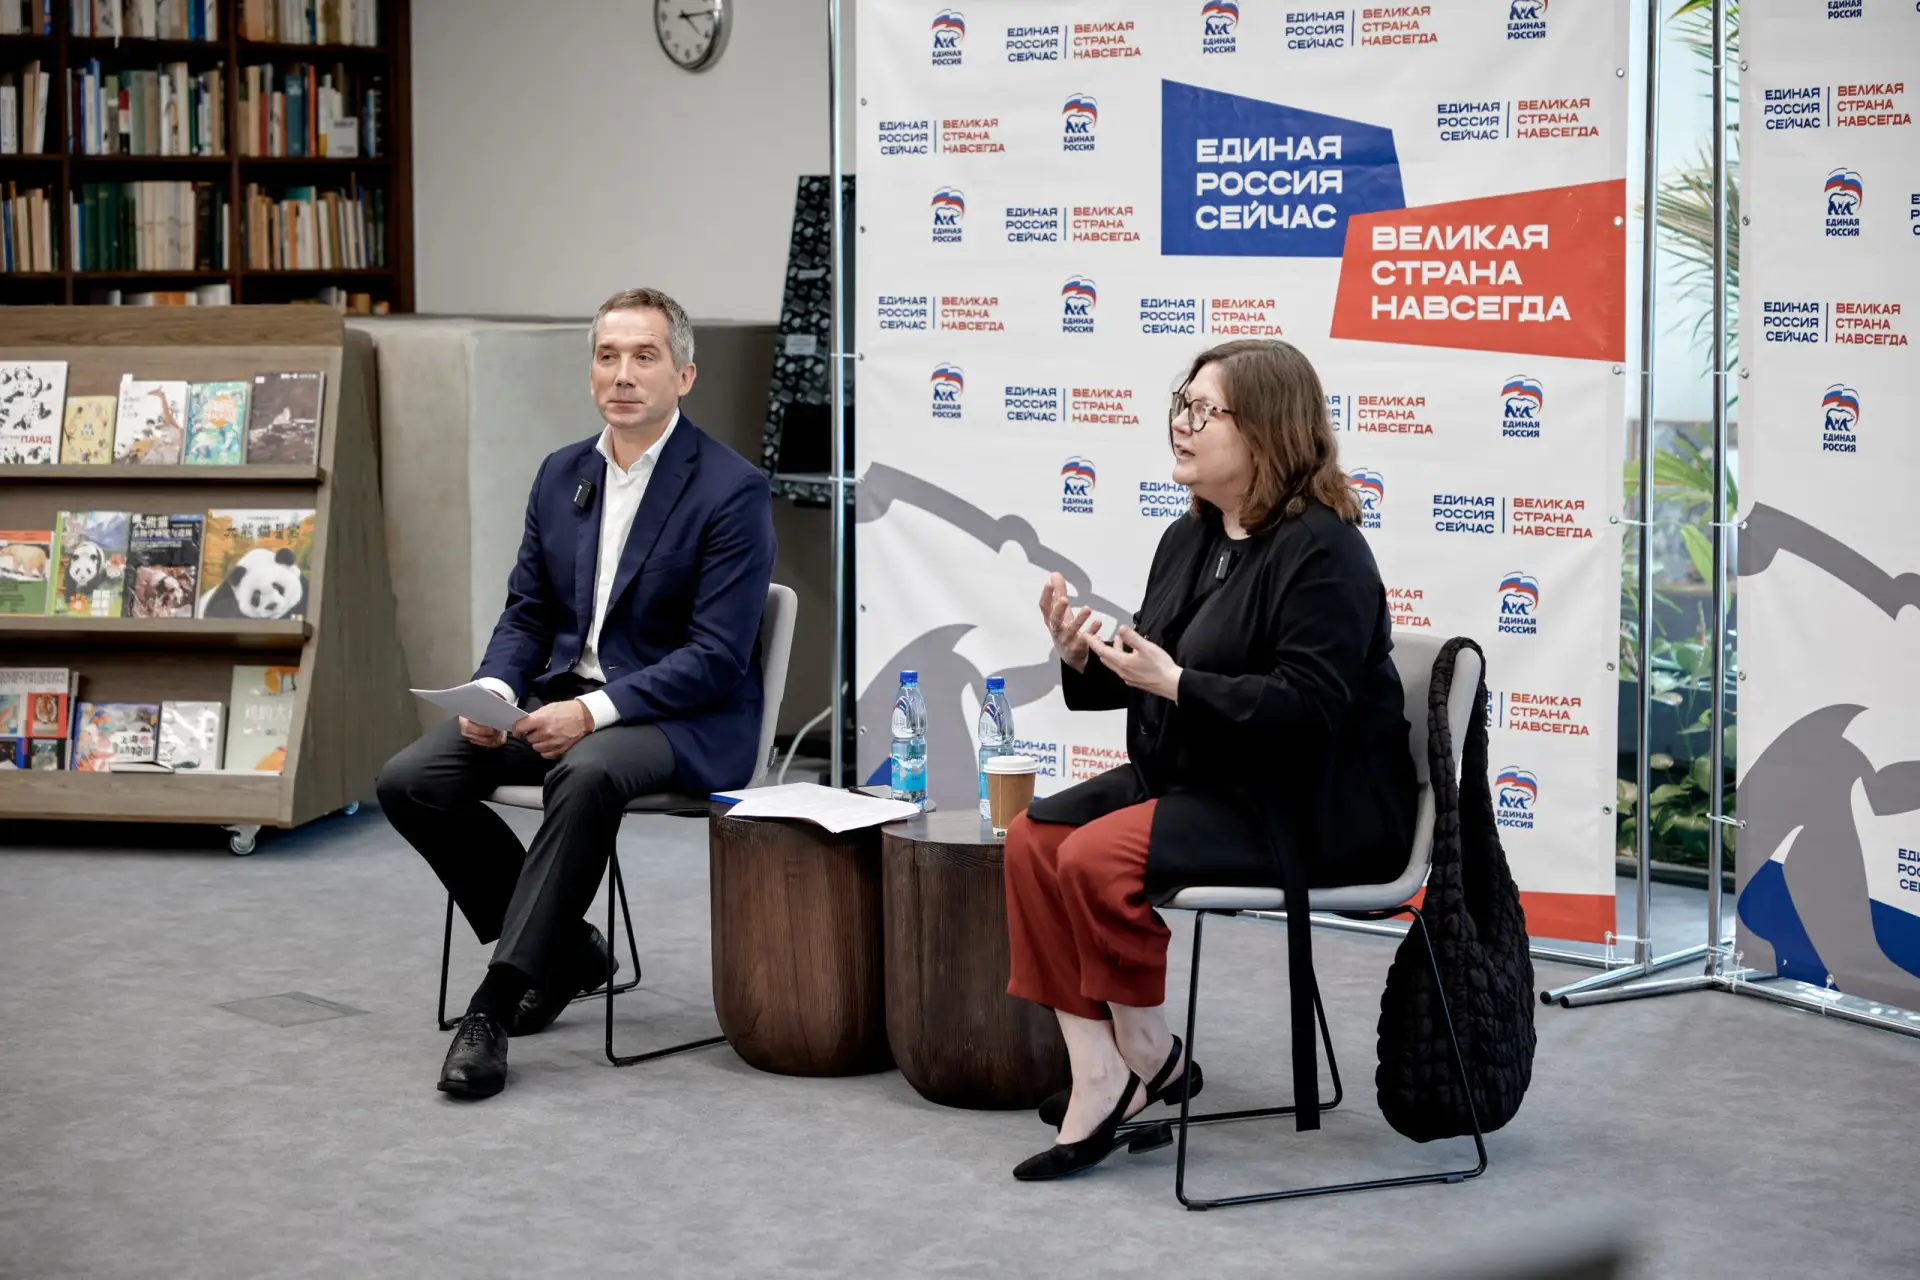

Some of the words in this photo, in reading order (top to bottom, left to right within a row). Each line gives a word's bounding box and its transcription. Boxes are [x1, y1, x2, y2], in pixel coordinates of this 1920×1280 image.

[1828, 0, 1862, 10] ЕДИНАЯ
[1286, 11, 1344, 23] ЕДИНАЯ
[1363, 6, 1431, 18] ВЕЛИКАЯ
[1828, 9, 1862, 19] РОССИЯ
[1008, 26, 1059, 37] ЕДИНАЯ
[1074, 22, 1134, 34] ВЕЛИКАЯ
[1286, 24, 1344, 36] РОССИЯ
[1362, 20, 1420, 32] СТРАНА
[1508, 22, 1546, 30] ЕДИНАЯ
[1362, 33, 1438, 46] НАВСЕГДА
[1508, 30, 1546, 39] РОССИЯ
[1006, 39, 1058, 50] РОССИЯ
[1074, 35, 1125, 46] СТРАНА
[1203, 37, 1236, 46] ЕДИНАЯ
[1288, 37, 1344, 50] СЕЙЧАС
[932, 50, 962, 58] ЕДИНАЯ
[1074, 47, 1141, 58] НАВСЕГДА
[1203, 45, 1236, 54] РОССИЯ
[1008, 50, 1058, 62] СЕЙЧАС
[932, 58, 962, 66] РОССИЯ
[1765, 87, 1820, 100] ЕДИНАЯ
[1838, 83, 1904, 96] ВЕЛИКАЯ
[1438, 102, 1500, 114] ЕДИНАЯ
[1518, 98, 1590, 110] ВЕЛИКАЯ
[1764, 102, 1820, 115] РОССИЯ
[1837, 99, 1894, 112] СТРАНА
[942, 118, 998, 129] ВЕЛИКАЯ
[1438, 116, 1499, 128] РОССИЯ
[1518, 113, 1579, 124] СТРАНА
[1766, 117, 1820, 130] СЕЙЧАС
[1838, 114, 1912, 127] НАВСЕГДА
[879, 120, 928, 131] ЕДИНАЯ
[943, 132, 990, 141] СТРАНА
[1440, 129, 1498, 141] СЕЙЧАС
[1518, 126, 1599, 138] НАВСЕГДА
[879, 133, 928, 143] РОССИЯ
[1064, 136, 1094, 144] ЕДИНАЯ
[881, 144, 927, 155] СЕЙЧАС
[943, 144, 1005, 153] НАВСЕГДА
[1197, 136, 1342, 164] ЕДИНАЯ
[1197, 170, 1342, 196] РОССИЯ
[1006, 208, 1058, 217] ЕДИНАЯ
[1074, 206, 1133, 216] ВЕЛИКАЯ
[1196, 200, 1336, 230] СЕЙЧАС
[1006, 220, 1058, 230] РОССИЯ
[1073, 220, 1124, 228] СТРАНА
[1826, 218, 1859, 227] ЕДИНАЯ
[1008, 232, 1057, 242] СЕЙЧАС
[1073, 232, 1140, 241] НАВСЕГДА
[1372, 224, 1548, 250] ВЕЛИКАЯ
[1826, 228, 1859, 236] РОССИЯ
[1372, 260, 1522, 285] СТРАНА
[879, 296, 927, 305] ЕДИНАЯ
[942, 296, 998, 306] ВЕЛИКАЯ
[1140, 298, 1195, 308] ЕДИНАЯ
[1212, 299, 1275, 308] ВЕЛИКАЯ
[878, 308, 927, 318] РОССИЯ
[1372, 295, 1571, 322] НАВСЕГДА
[1764, 302, 1819, 313] ЕДИНАЯ
[1836, 303, 1900, 314] ВЕЛИКАЯ
[942, 309, 990, 318] СТРАНА
[1140, 312, 1195, 321] РОССИЯ
[1212, 312, 1265, 322] СТРАНА
[880, 320, 926, 330] СЕЙЧАС
[942, 322, 1004, 331] НАВСЕГДА
[1764, 316, 1818, 328] РОССИЯ
[1836, 318, 1890, 330] СТРАНА
[1142, 323, 1194, 334] СЕЙЧАС
[1212, 326, 1282, 335] НАВСЕГДА
[1766, 330, 1818, 343] СЕЙЧАС
[1836, 333, 1908, 346] НАВСЕГДА
[1005, 386, 1056, 396] ЕДИНАЯ
[1072, 388, 1132, 398] ВЕЛИКАЯ
[1005, 399, 1056, 409] РОССИЯ
[1072, 401, 1123, 411] СТРАНА
[1358, 396, 1425, 406] ВЕЛИКАЯ
[1007, 411, 1056, 422] СЕЙЧАС
[1072, 414, 1139, 424] НАВСЕГДА
[1358, 409, 1415, 420] СТРАНА
[1358, 423, 1433, 434] НАВСЕГДА
[1503, 430, 1540, 438] РОССИЯ
[1824, 433, 1856, 442] ЕДИНАЯ
[1823, 443, 1856, 452] РОССИЯ
[1434, 495, 1494, 506] ЕДИНАЯ
[1514, 498, 1584, 510] ВЕЛИКАЯ
[1142, 507, 1184, 517] СЕЙЧА
[1433, 508, 1494, 520] РОССИЯ
[1513, 512, 1574, 523] СТРАНА
[1436, 521, 1494, 534] СЕЙЧАС
[1514, 526, 1592, 538] НАВСЕГДА
[1499, 617, 1536, 625] ЕДИНАЯ
[1498, 625, 1536, 634] РОССИЯ
[1511, 692, 1581, 707] ВЕЛИКАЯ
[1510, 706, 1570, 720] СТРАНА
[1510, 720, 1589, 736] НАВСЕГДА
[1014, 740, 1056, 752] ДИНАЯ
[1497, 810, 1534, 820] ЕДИНАЯ
[1497, 818, 1533, 828] РОССИЯ
